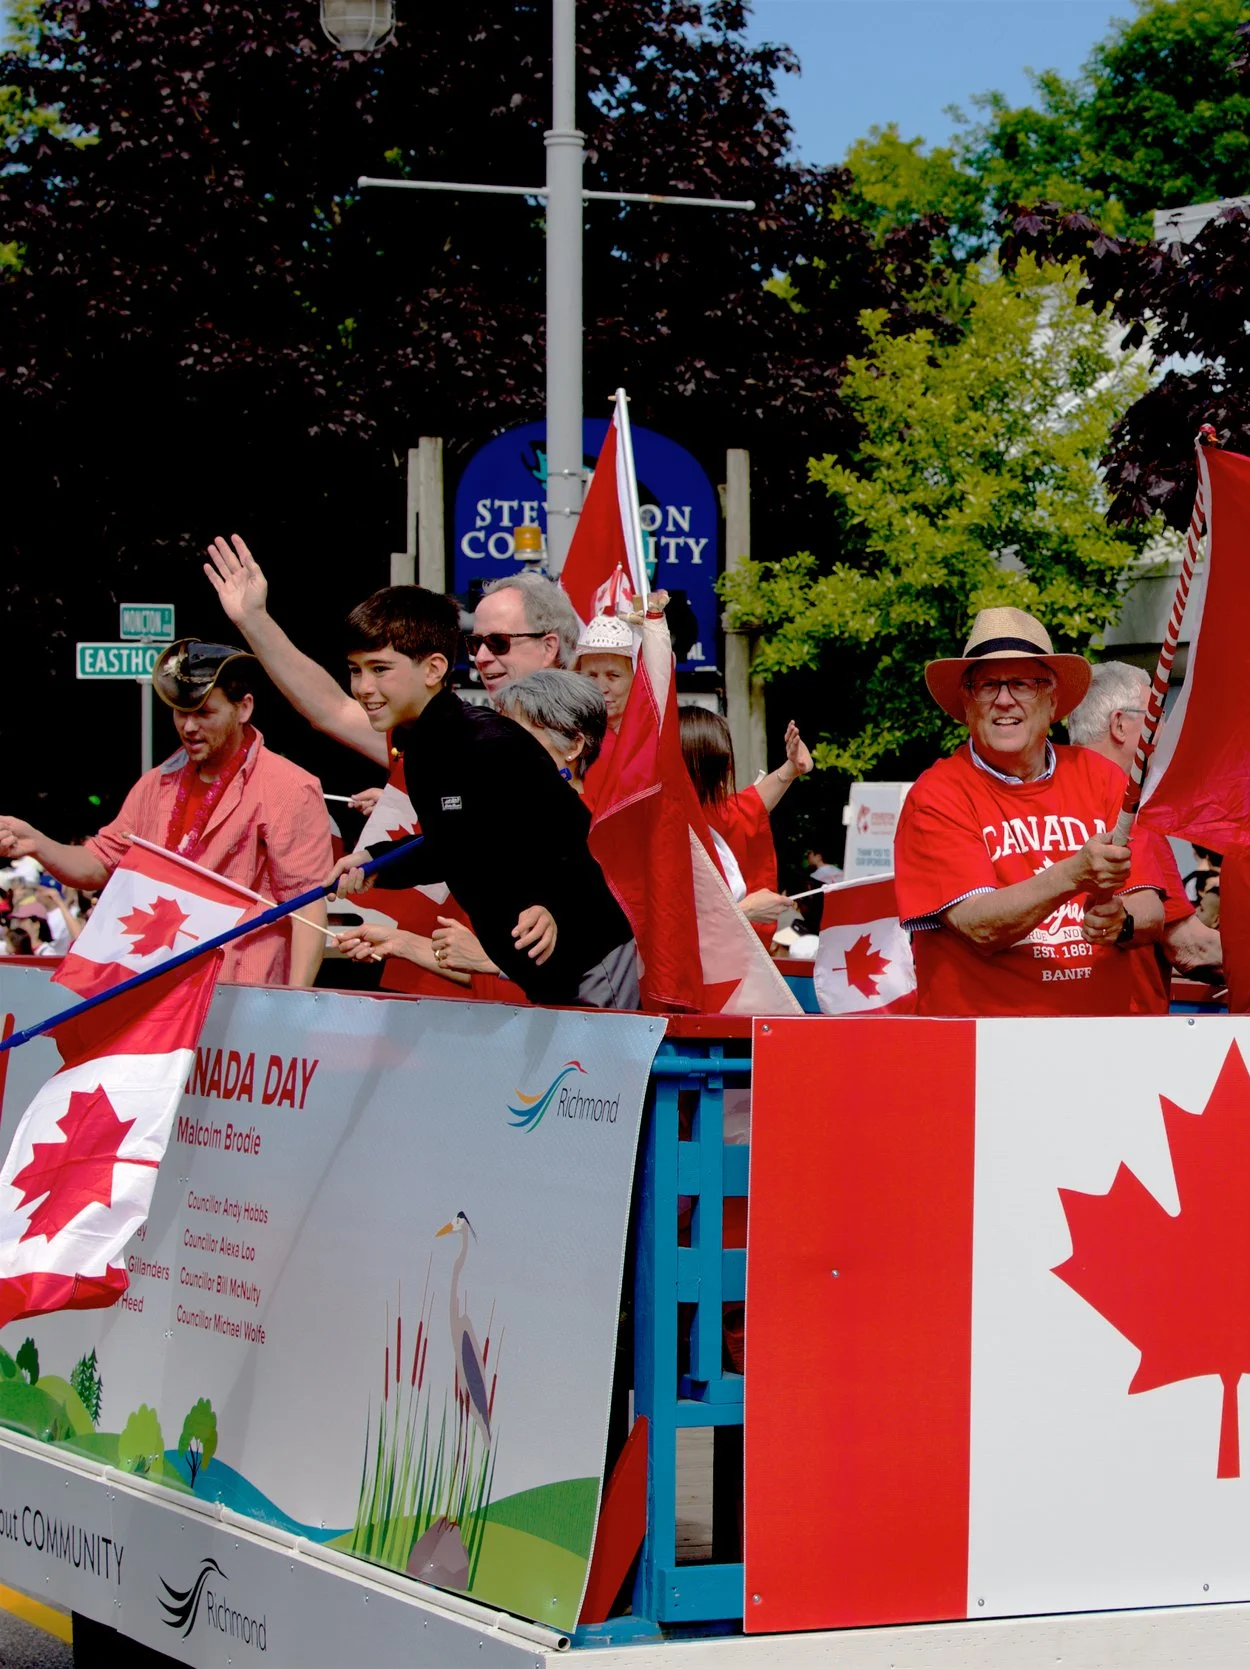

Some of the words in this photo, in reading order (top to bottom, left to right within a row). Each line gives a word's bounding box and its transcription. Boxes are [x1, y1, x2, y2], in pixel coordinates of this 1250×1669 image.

[475, 498, 692, 533] STEON
[460, 529, 709, 565] COITY
[84, 648, 157, 673] EASTHO
[1028, 929, 1047, 942] RUE
[1033, 945, 1059, 959] EST.
[1063, 943, 1093, 959] 1867
[1041, 966, 1092, 982] BANFF
[184, 1046, 256, 1103] NADA
[261, 1054, 320, 1110] DAY
[557, 1087, 621, 1124] Richmond
[176, 1115, 223, 1148] Malcolm
[223, 1123, 261, 1155] Brodie
[187, 1190, 222, 1215] Councillor
[222, 1197, 243, 1224] Andy
[243, 1202, 269, 1224] Hobbs
[183, 1228, 219, 1253] Councillor
[219, 1236, 240, 1258] Alexa
[241, 1241, 256, 1261] Loo
[127, 1255, 170, 1281] Gillanders
[122, 1291, 145, 1313] Heed
[180, 1266, 216, 1291] Councillor
[216, 1274, 228, 1296] Bill
[229, 1278, 261, 1308] McNulty
[176, 1304, 212, 1330] Councillor
[213, 1313, 243, 1339] Michael
[243, 1320, 266, 1344] Wolfe
[21, 1505, 124, 1586] COMMUNITY
[206, 1589, 268, 1652] Richmond
